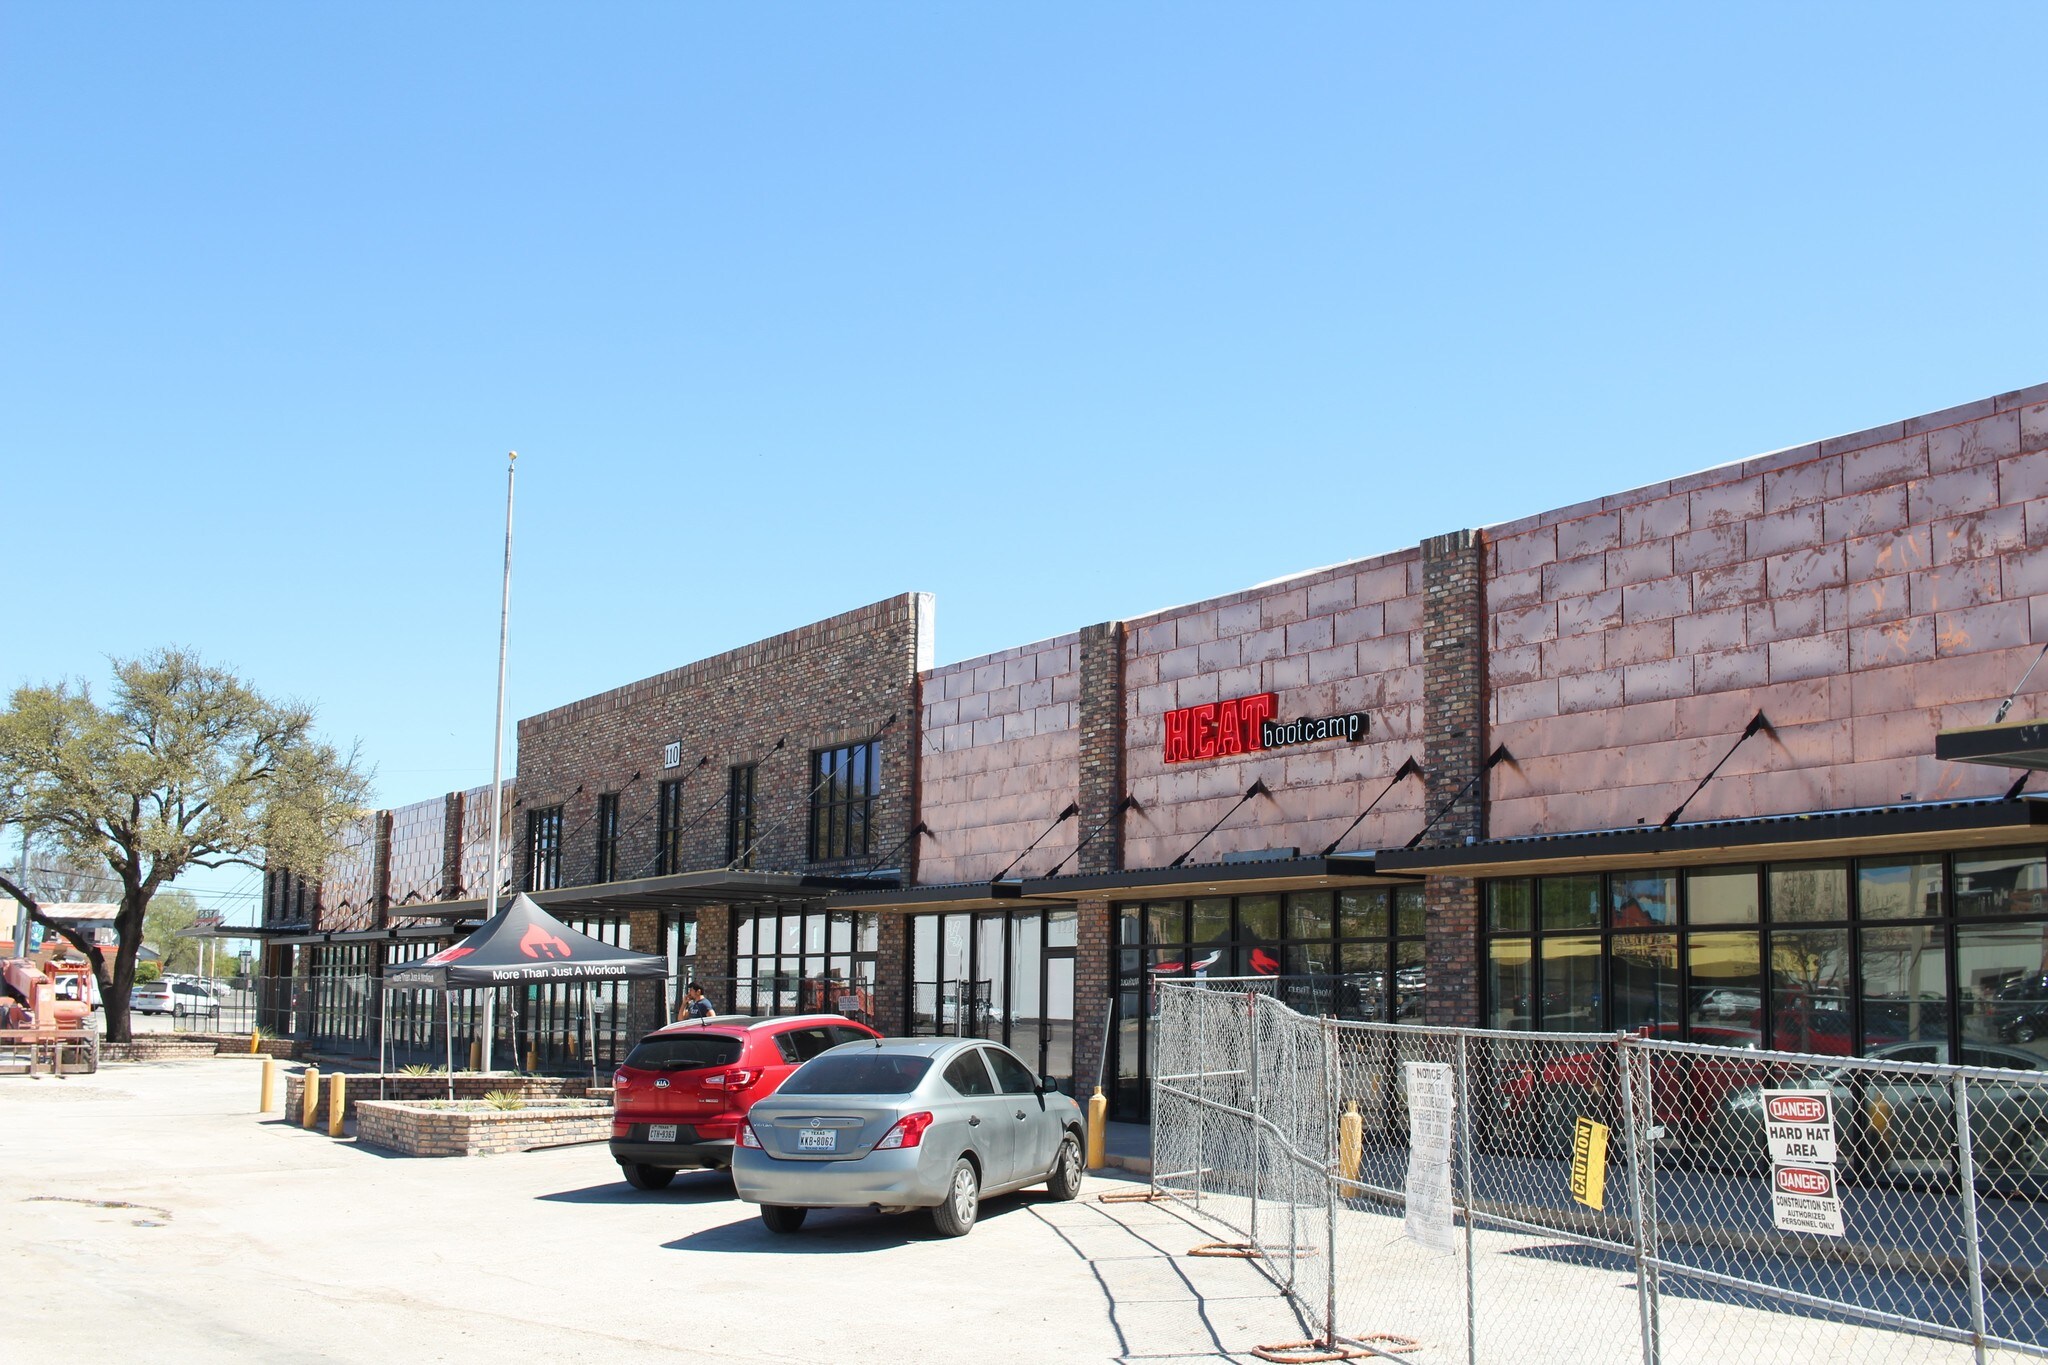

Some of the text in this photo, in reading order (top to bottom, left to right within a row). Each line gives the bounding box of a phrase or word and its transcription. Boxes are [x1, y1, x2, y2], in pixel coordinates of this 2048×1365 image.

[1164, 692, 1363, 763] HEAT bootcamp
[665, 745, 679, 765] 110
[493, 965, 627, 981] More Than Just A Workout
[1416, 1068, 1442, 1080] NOTICE
[1772, 1101, 1822, 1117] DANGER
[1770, 1126, 1830, 1141] HARD HAT
[1786, 1143, 1818, 1157] AREA
[1574, 1125, 1591, 1195] CAUTION
[1779, 1171, 1827, 1190] DANGER
[1776, 1195, 1837, 1212] CONSTRUCTION SITE
[1787, 1209, 1826, 1221] AUTHORIZED
[1781, 1217, 1835, 1230] PERSONNEL ONLY
